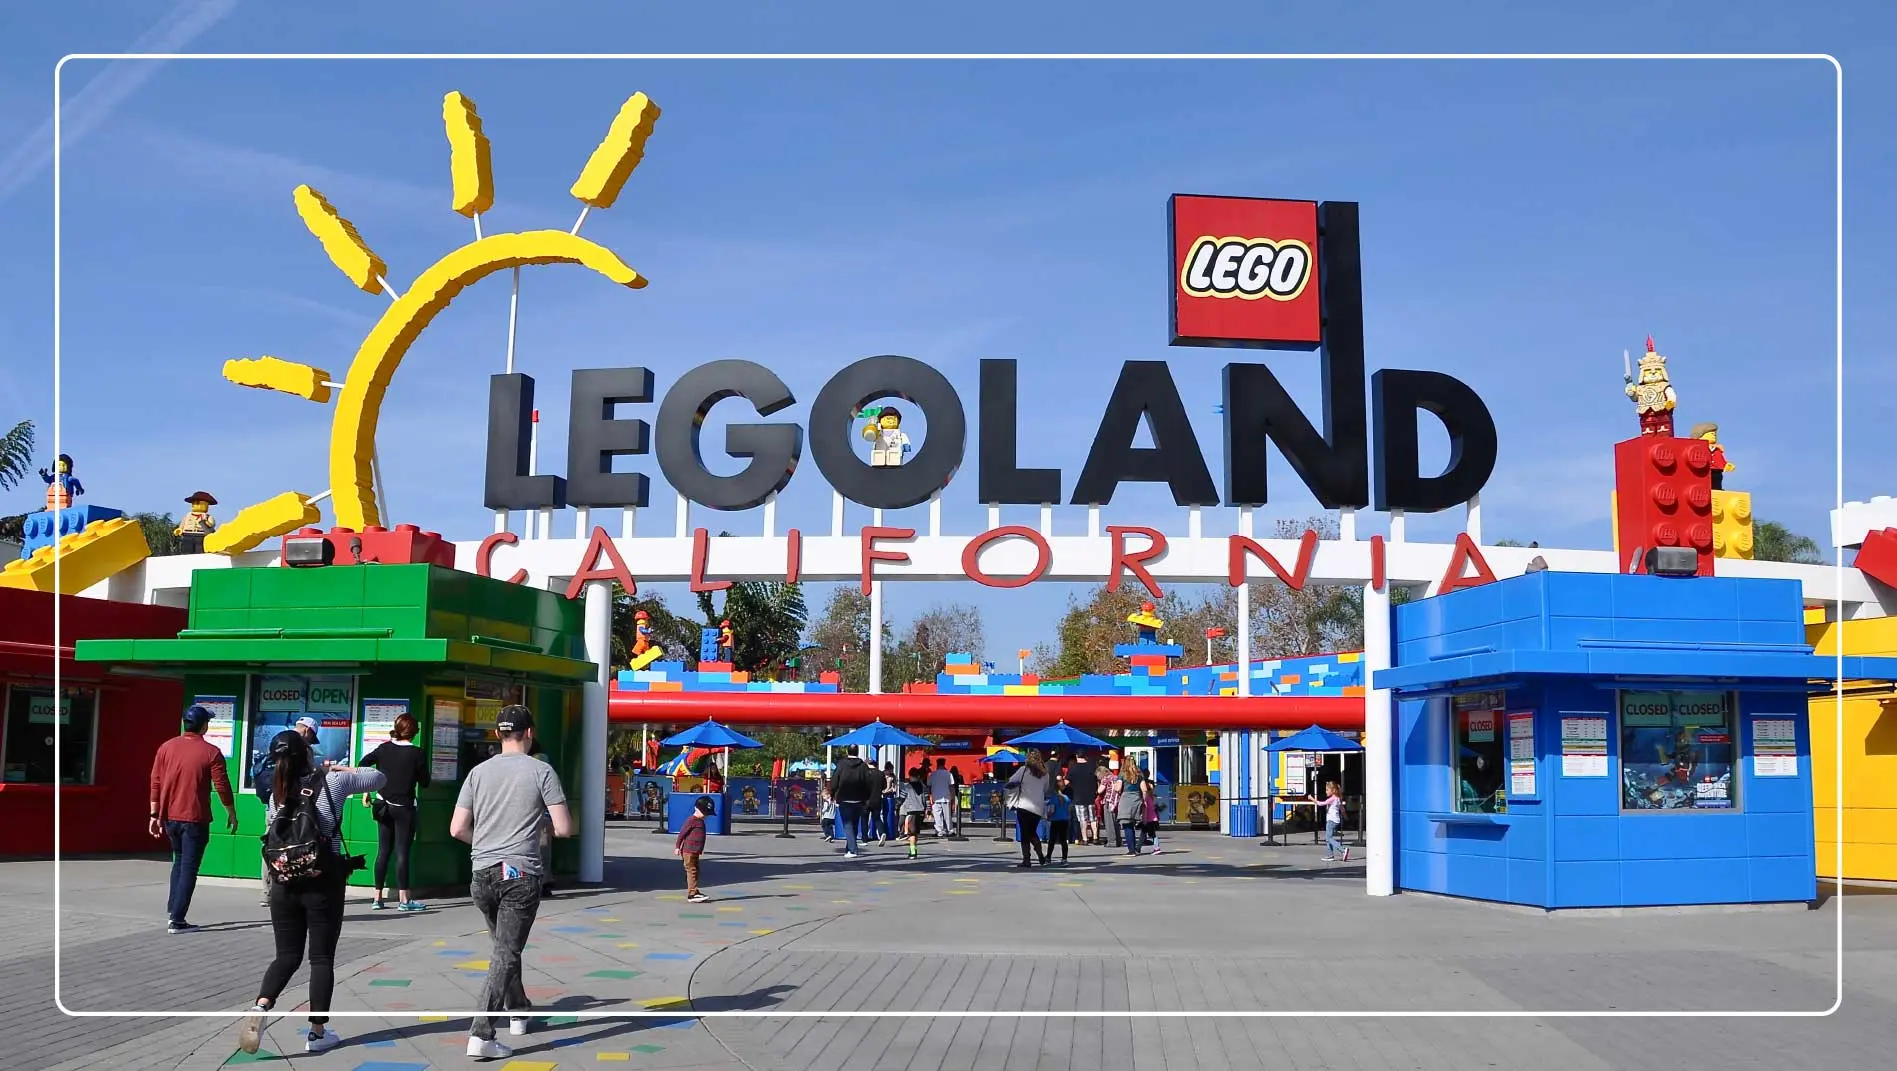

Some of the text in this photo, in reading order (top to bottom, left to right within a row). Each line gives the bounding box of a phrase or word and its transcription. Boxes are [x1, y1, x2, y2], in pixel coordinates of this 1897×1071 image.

[1185, 240, 1308, 297] LEGO
[484, 353, 1498, 513] LEGOLAND
[475, 525, 1498, 600] CALIFORNIA
[263, 689, 301, 701] CLOSED
[311, 688, 349, 704] OPEN
[1626, 704, 1668, 716] CLOSED
[1678, 703, 1720, 716] CLOSED
